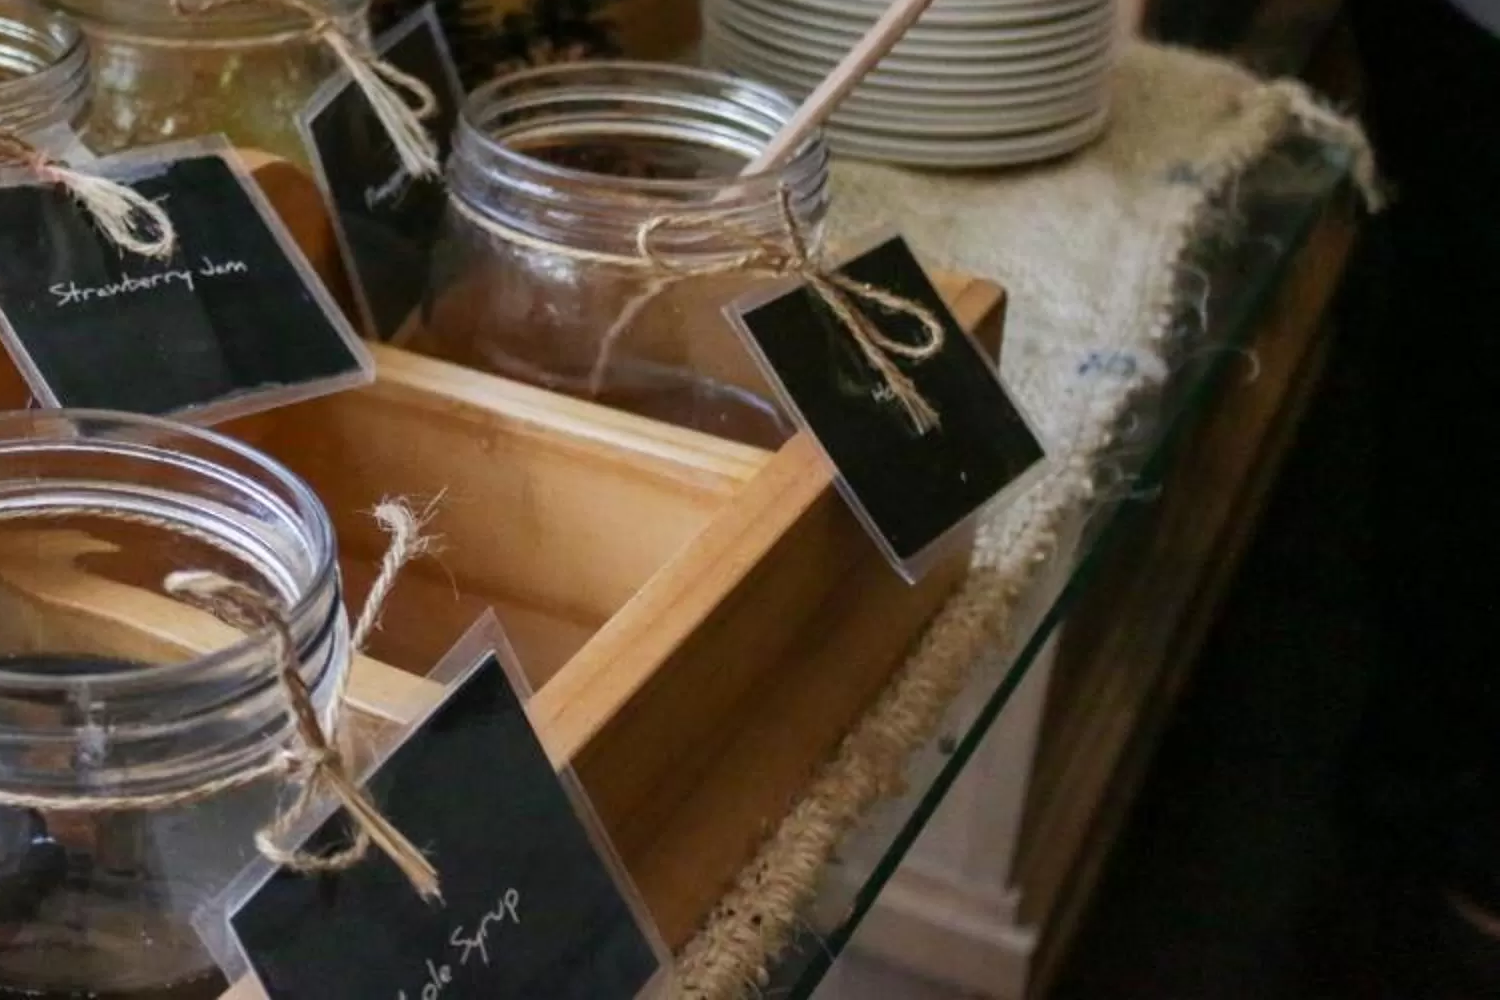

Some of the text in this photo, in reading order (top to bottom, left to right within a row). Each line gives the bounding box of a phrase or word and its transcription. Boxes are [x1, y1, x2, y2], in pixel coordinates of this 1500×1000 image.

[49, 255, 249, 308] Strawberry Jam
[449, 886, 521, 966] Syrup
